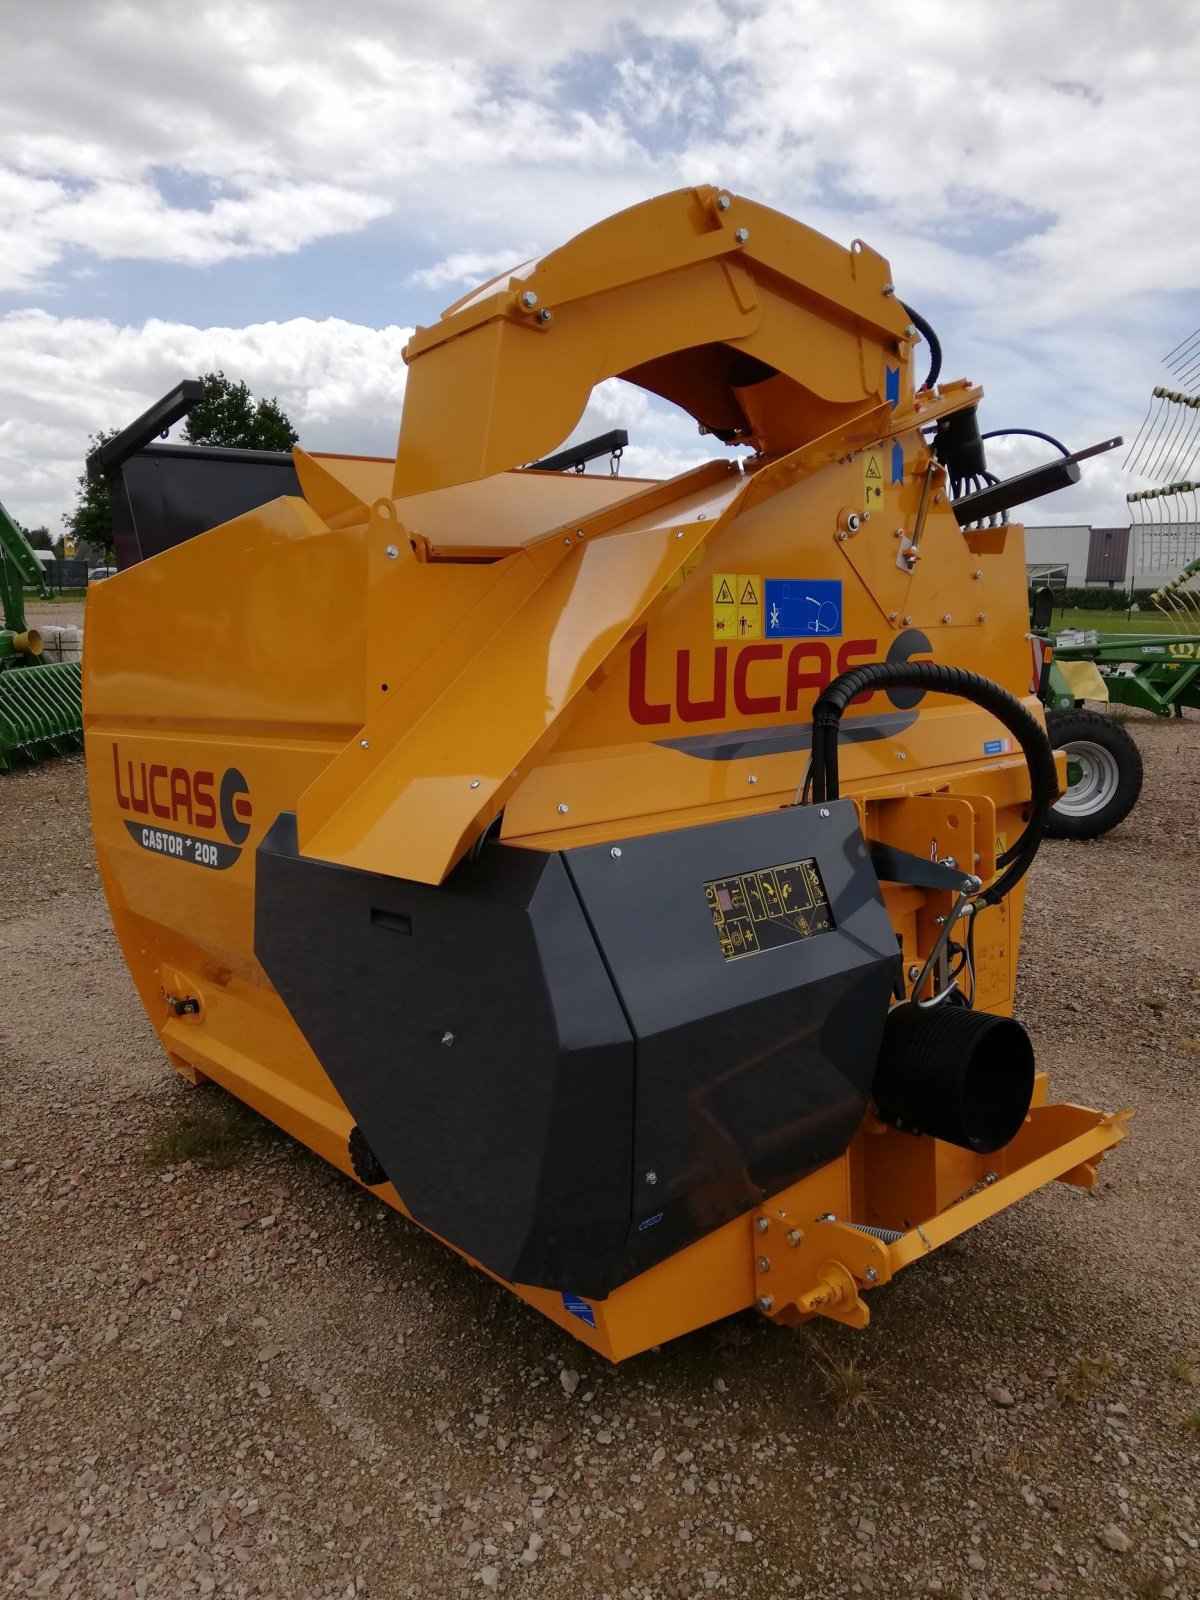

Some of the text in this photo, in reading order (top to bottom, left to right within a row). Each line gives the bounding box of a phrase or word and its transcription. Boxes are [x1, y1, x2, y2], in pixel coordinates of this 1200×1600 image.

[629, 629, 877, 725] LUCAS
[112, 742, 217, 829] LUCAS
[194, 842, 218, 866] 20R
